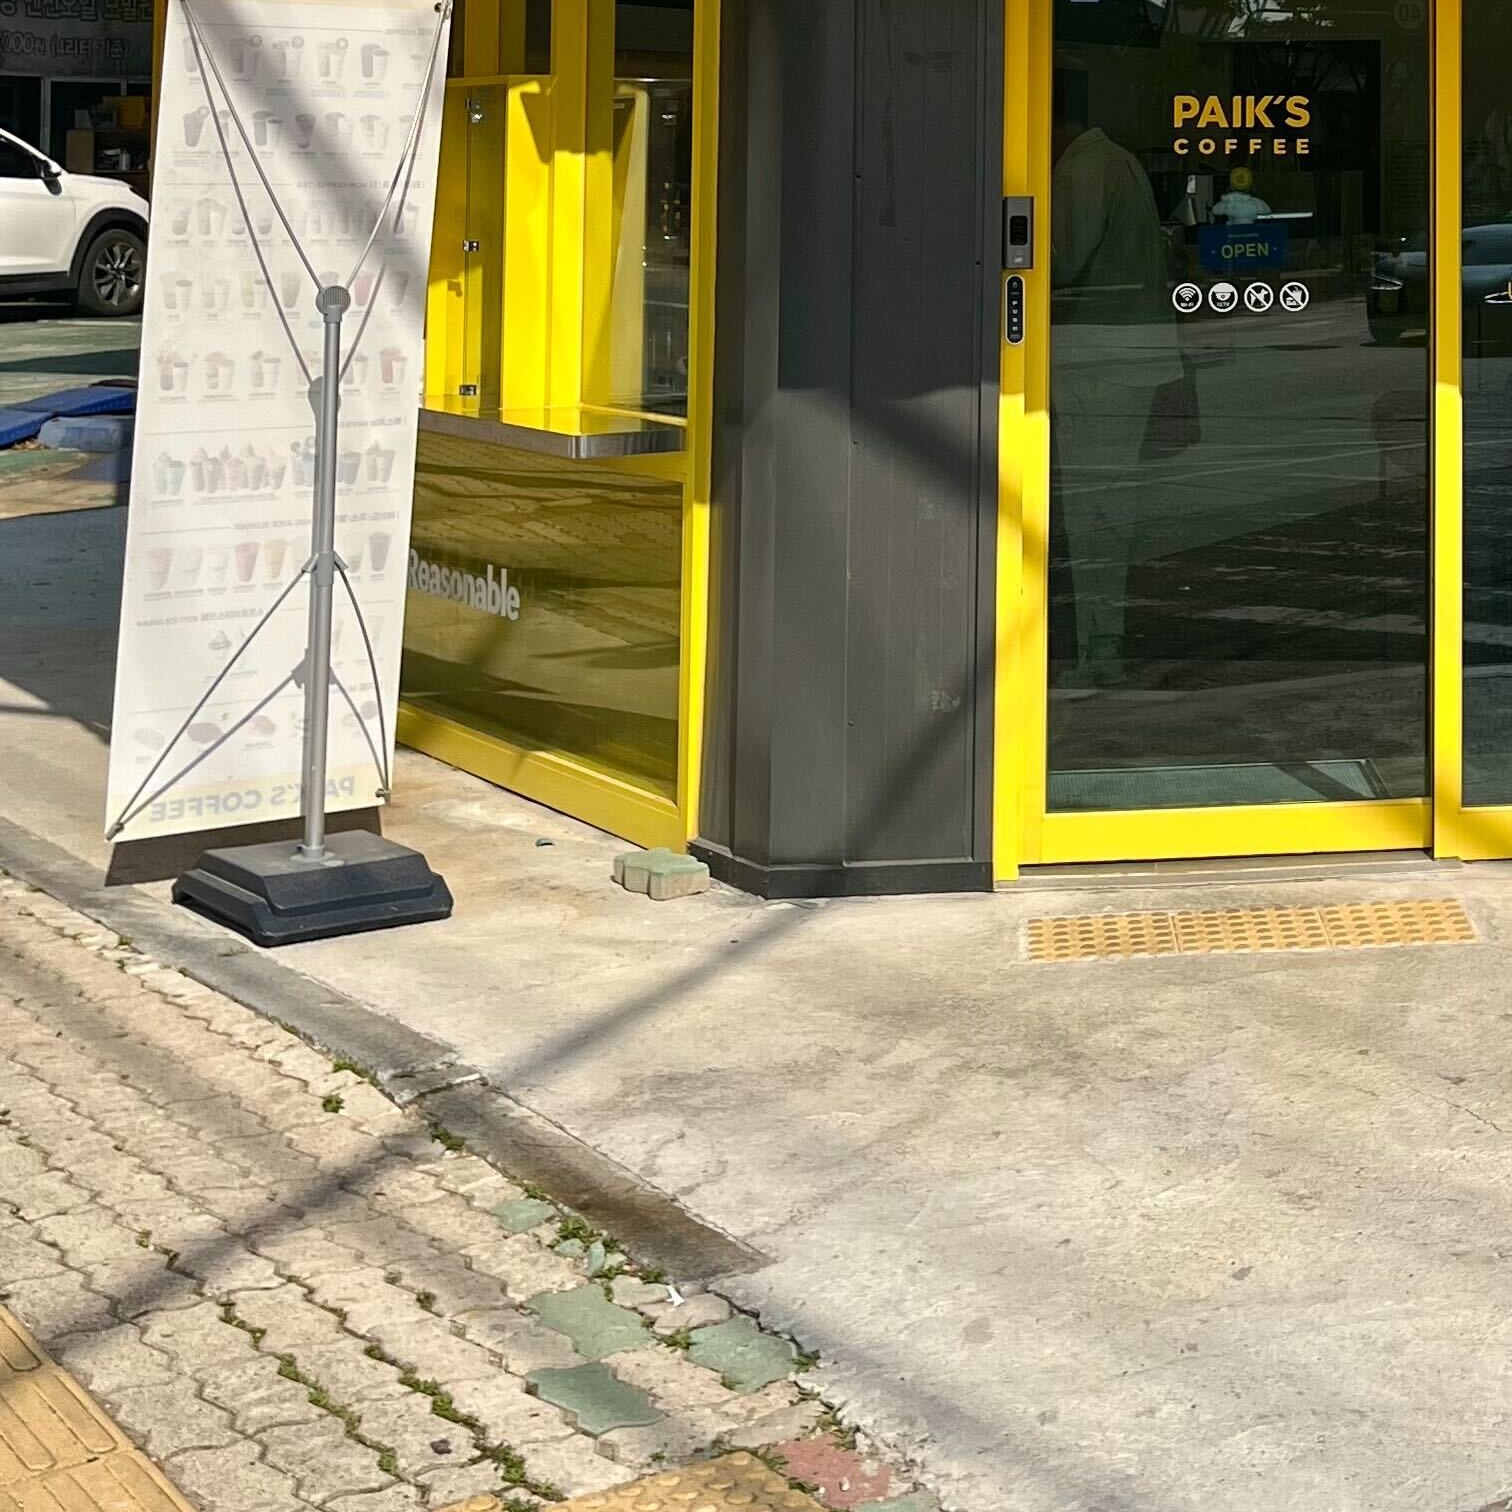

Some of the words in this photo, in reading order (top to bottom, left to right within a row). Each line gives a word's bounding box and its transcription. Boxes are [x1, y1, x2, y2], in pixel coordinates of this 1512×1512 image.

[1173, 95, 1311, 129] PAIK'S
[1173, 138, 1310, 155] COFFEE
[1221, 242, 1269, 259] OPEN
[408, 548, 520, 621] Reasonable
